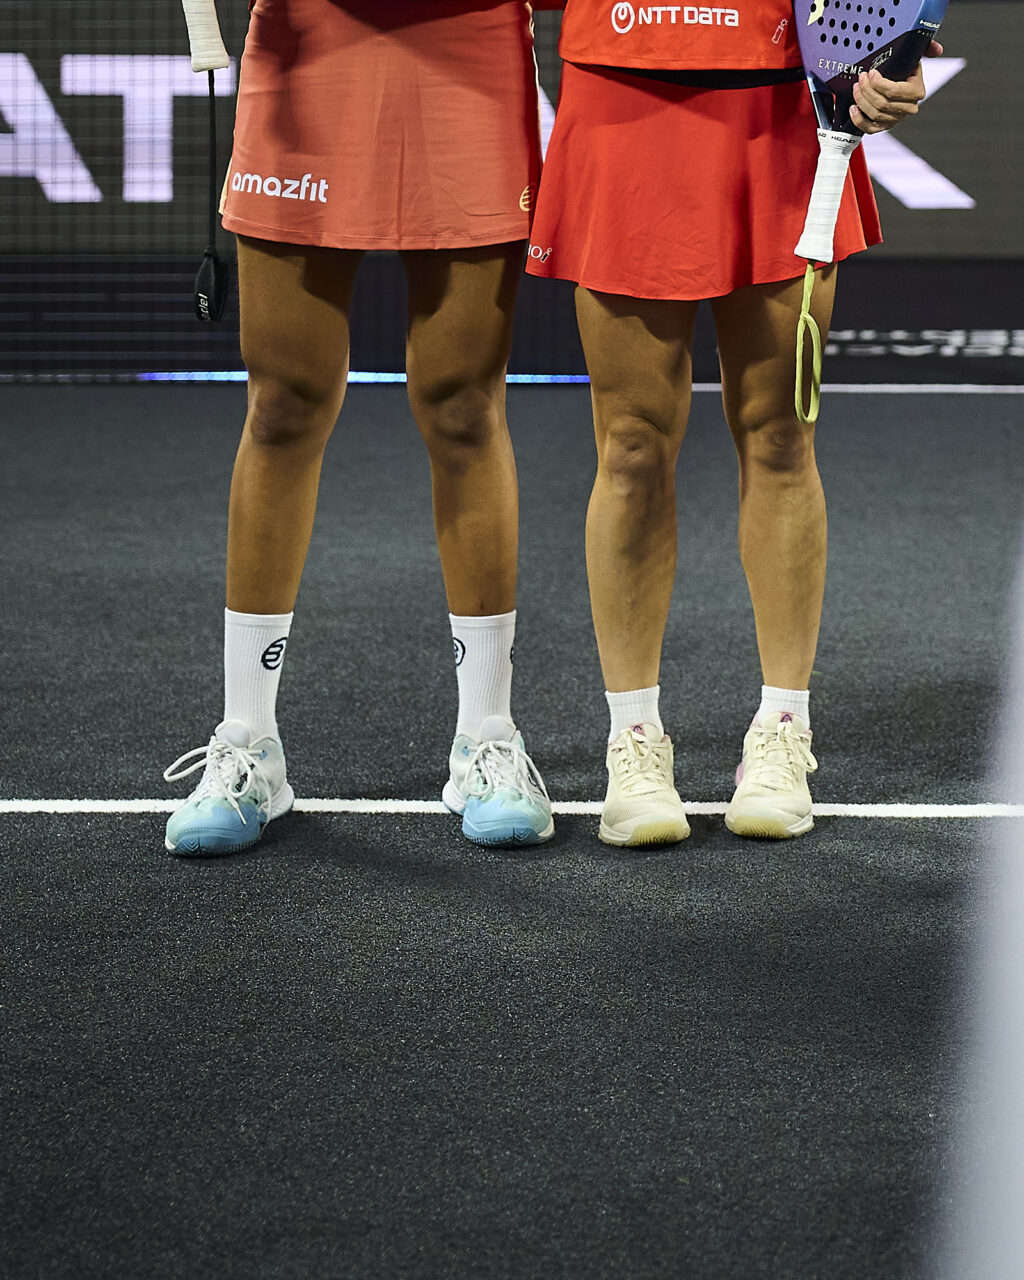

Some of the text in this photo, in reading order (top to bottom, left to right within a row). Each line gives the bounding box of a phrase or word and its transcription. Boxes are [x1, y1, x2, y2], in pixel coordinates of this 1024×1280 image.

[638, 6, 682, 25] NTT
[818, 58, 864, 76] EXTREME
[831, 135, 856, 144] HEAD
[232, 172, 329, 203] amazfit
